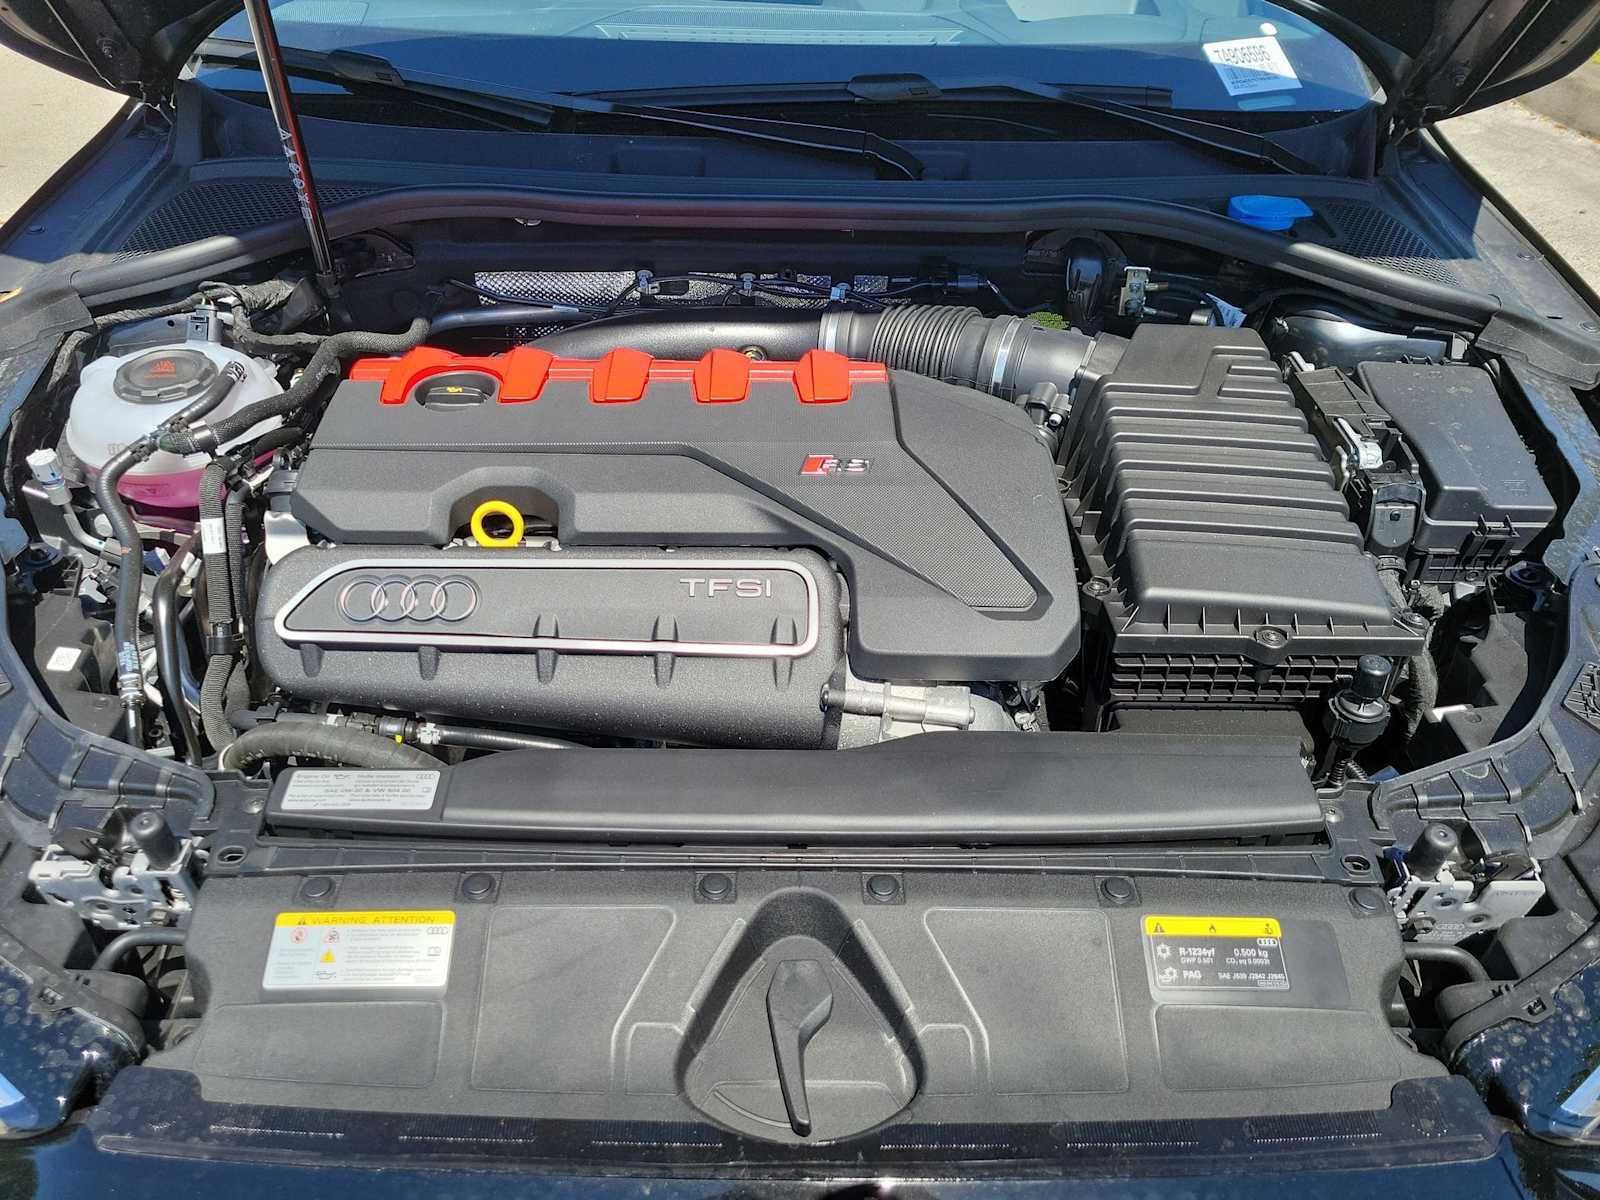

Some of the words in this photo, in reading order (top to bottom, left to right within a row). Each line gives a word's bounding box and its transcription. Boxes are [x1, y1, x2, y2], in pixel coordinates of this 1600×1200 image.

[680, 579, 771, 598] TFSI
[310, 916, 368, 925] WARNING
[374, 915, 436, 925] ATTENTION
[1179, 947, 1215, 957] R-1234yf
[1233, 948, 1256, 957] 0.500
[1258, 948, 1269, 958] kg
[1182, 970, 1202, 979] PAG
